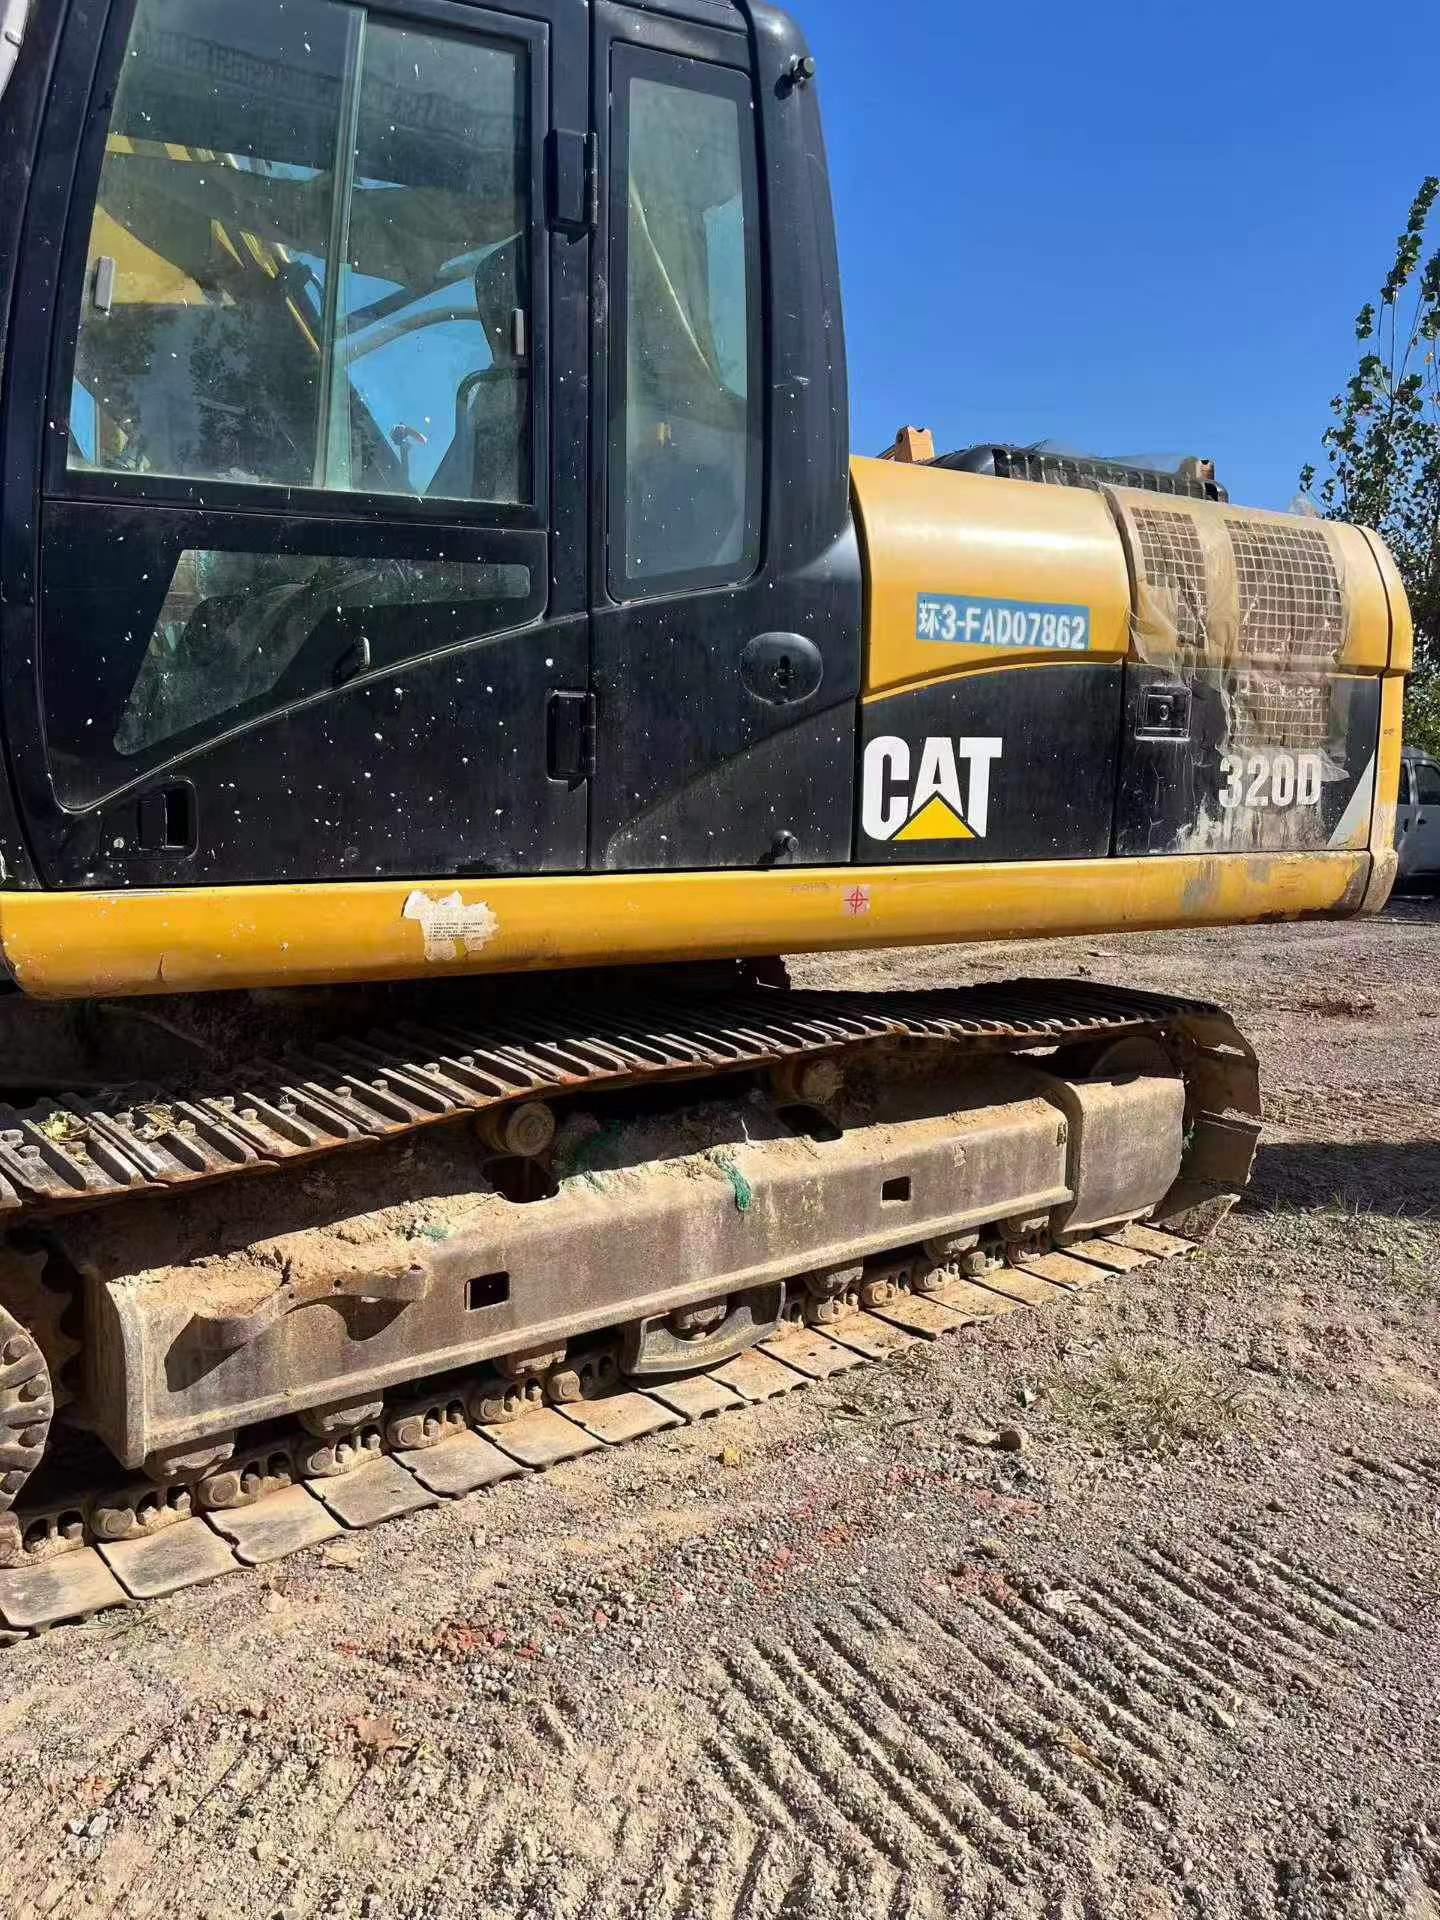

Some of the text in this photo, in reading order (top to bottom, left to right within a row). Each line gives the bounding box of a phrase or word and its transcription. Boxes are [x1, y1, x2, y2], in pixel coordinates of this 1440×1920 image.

[918, 602, 1086, 649] 环3-FAD07862
[862, 736, 1003, 841] CAT
[1218, 754, 1323, 807] 320D
